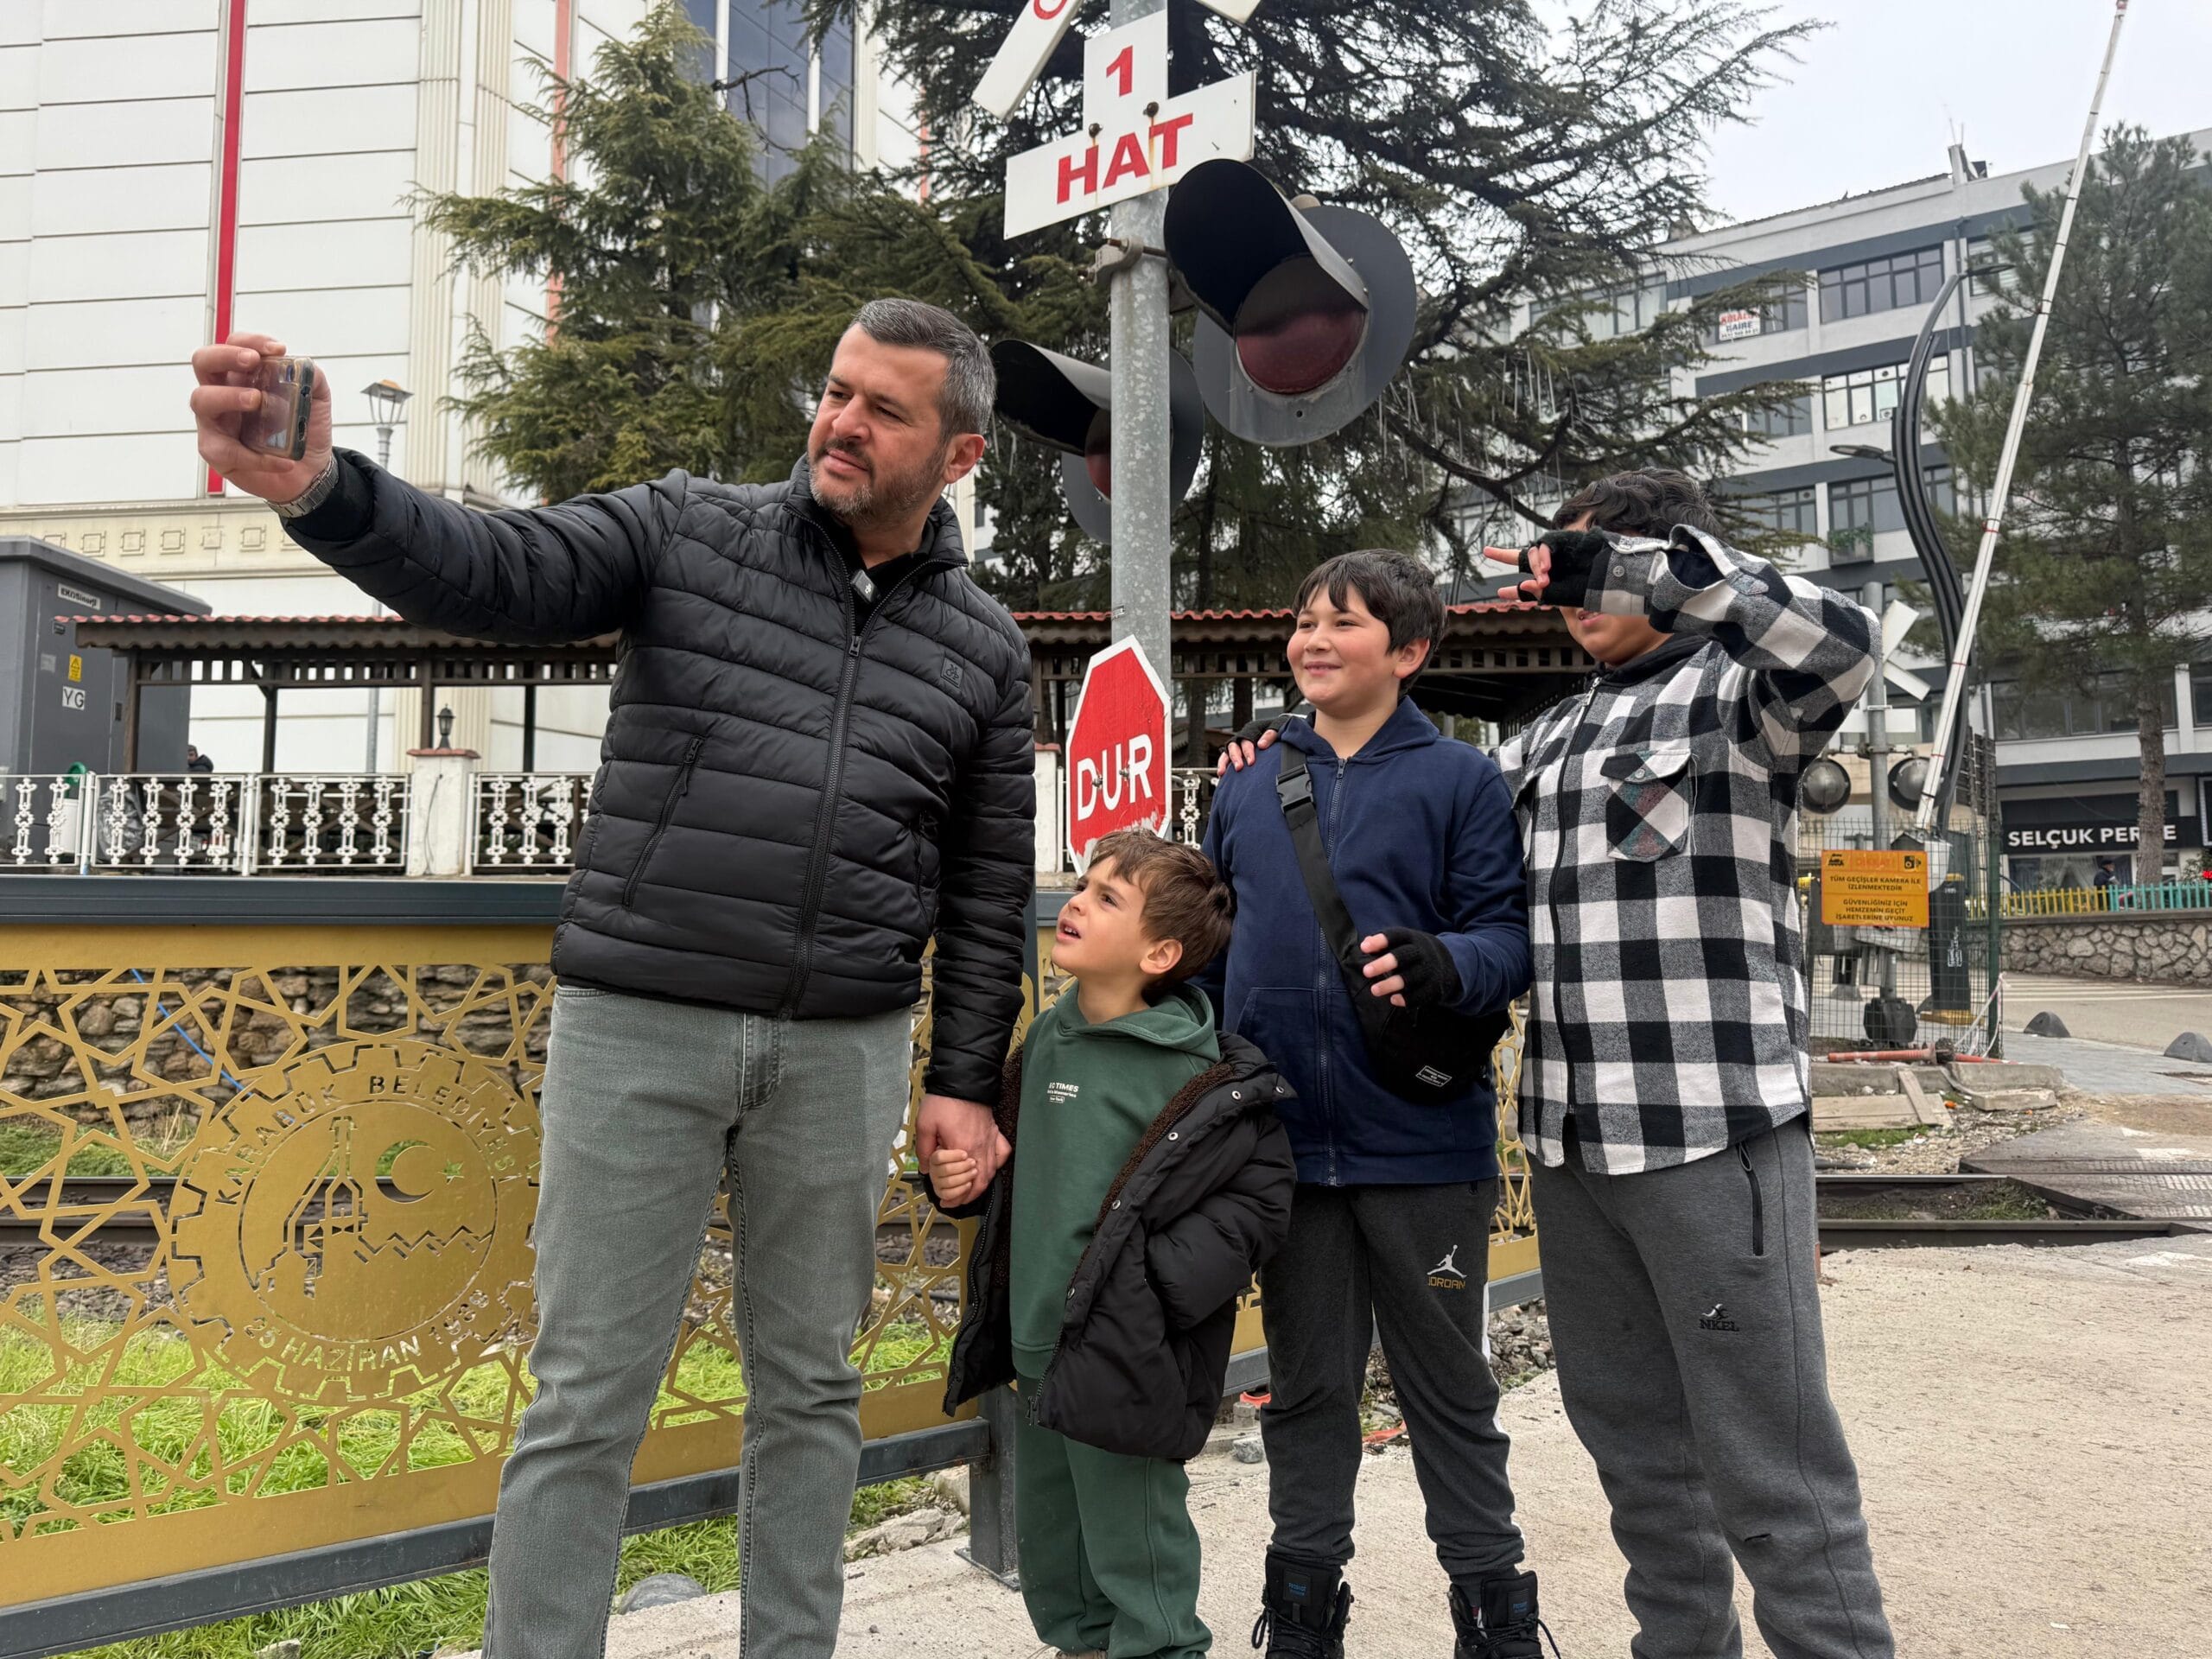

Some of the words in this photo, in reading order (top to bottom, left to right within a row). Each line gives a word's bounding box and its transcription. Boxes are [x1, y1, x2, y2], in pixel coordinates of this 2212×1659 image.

[1106, 46, 1133, 97] 1
[1057, 113, 1193, 205] HAT
[63, 689, 84, 709] YG
[1077, 734, 1153, 822] DUR
[2007, 828, 2094, 849] SELÇUK
[2100, 824, 2177, 843] PERE
[1846, 875, 1878, 885] GEÇİŞLER
[1910, 876, 1921, 885] İLE
[1847, 883, 1903, 892] İZLENMEKTEDİR
[1885, 907, 1905, 916] GEÇİT
[1893, 899, 1909, 908] İÇİN
[1056, 1082, 1079, 1093] TIMES
[243, 1317, 283, 1349] 25
[1698, 1319, 1740, 1332] NKEL
